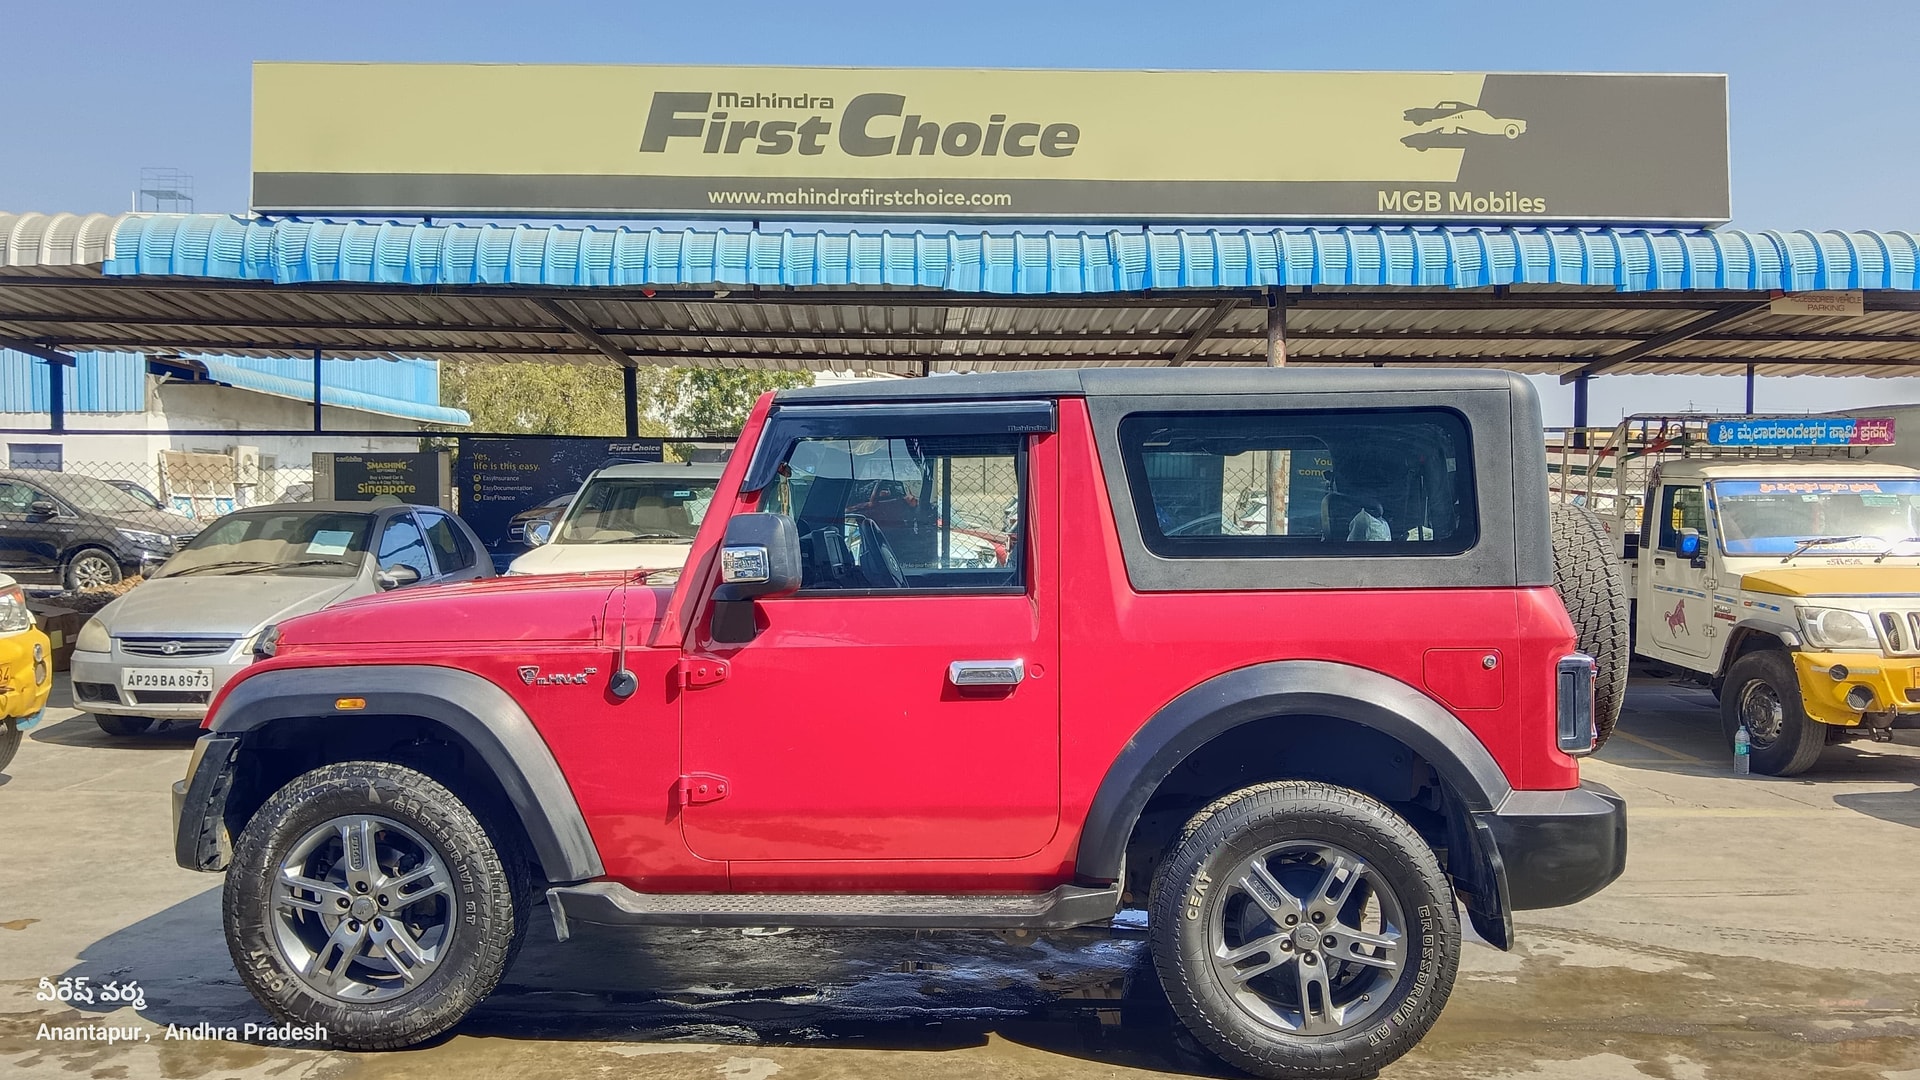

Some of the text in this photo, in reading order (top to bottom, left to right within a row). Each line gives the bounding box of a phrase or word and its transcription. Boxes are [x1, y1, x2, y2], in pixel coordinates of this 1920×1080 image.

[717, 92, 834, 109] Mahindra
[639, 91, 1081, 157] First Choice
[708, 188, 1013, 207] www.mahindrafirstchoice.com
[1378, 190, 1546, 213] MGB Mobiles
[1790, 295, 1862, 304] ACCESSORIES VEHICLE
[1807, 304, 1845, 312] PARKING
[1718, 425, 1734, 443] ಶ್ರೀ
[1829, 424, 1858, 443] ಸ್ವಾಮಿ
[608, 443, 661, 451] First Choice
[366, 461, 407, 470] SMASHING
[473, 452, 491, 462] Yes,
[473, 461, 541, 472] life is this easy.
[357, 483, 416, 496] Singapore
[1186, 870, 1214, 921] CEAT
[250, 949, 285, 992] CEAT
[1369, 904, 1434, 1046] CROSSDRIVE AT
